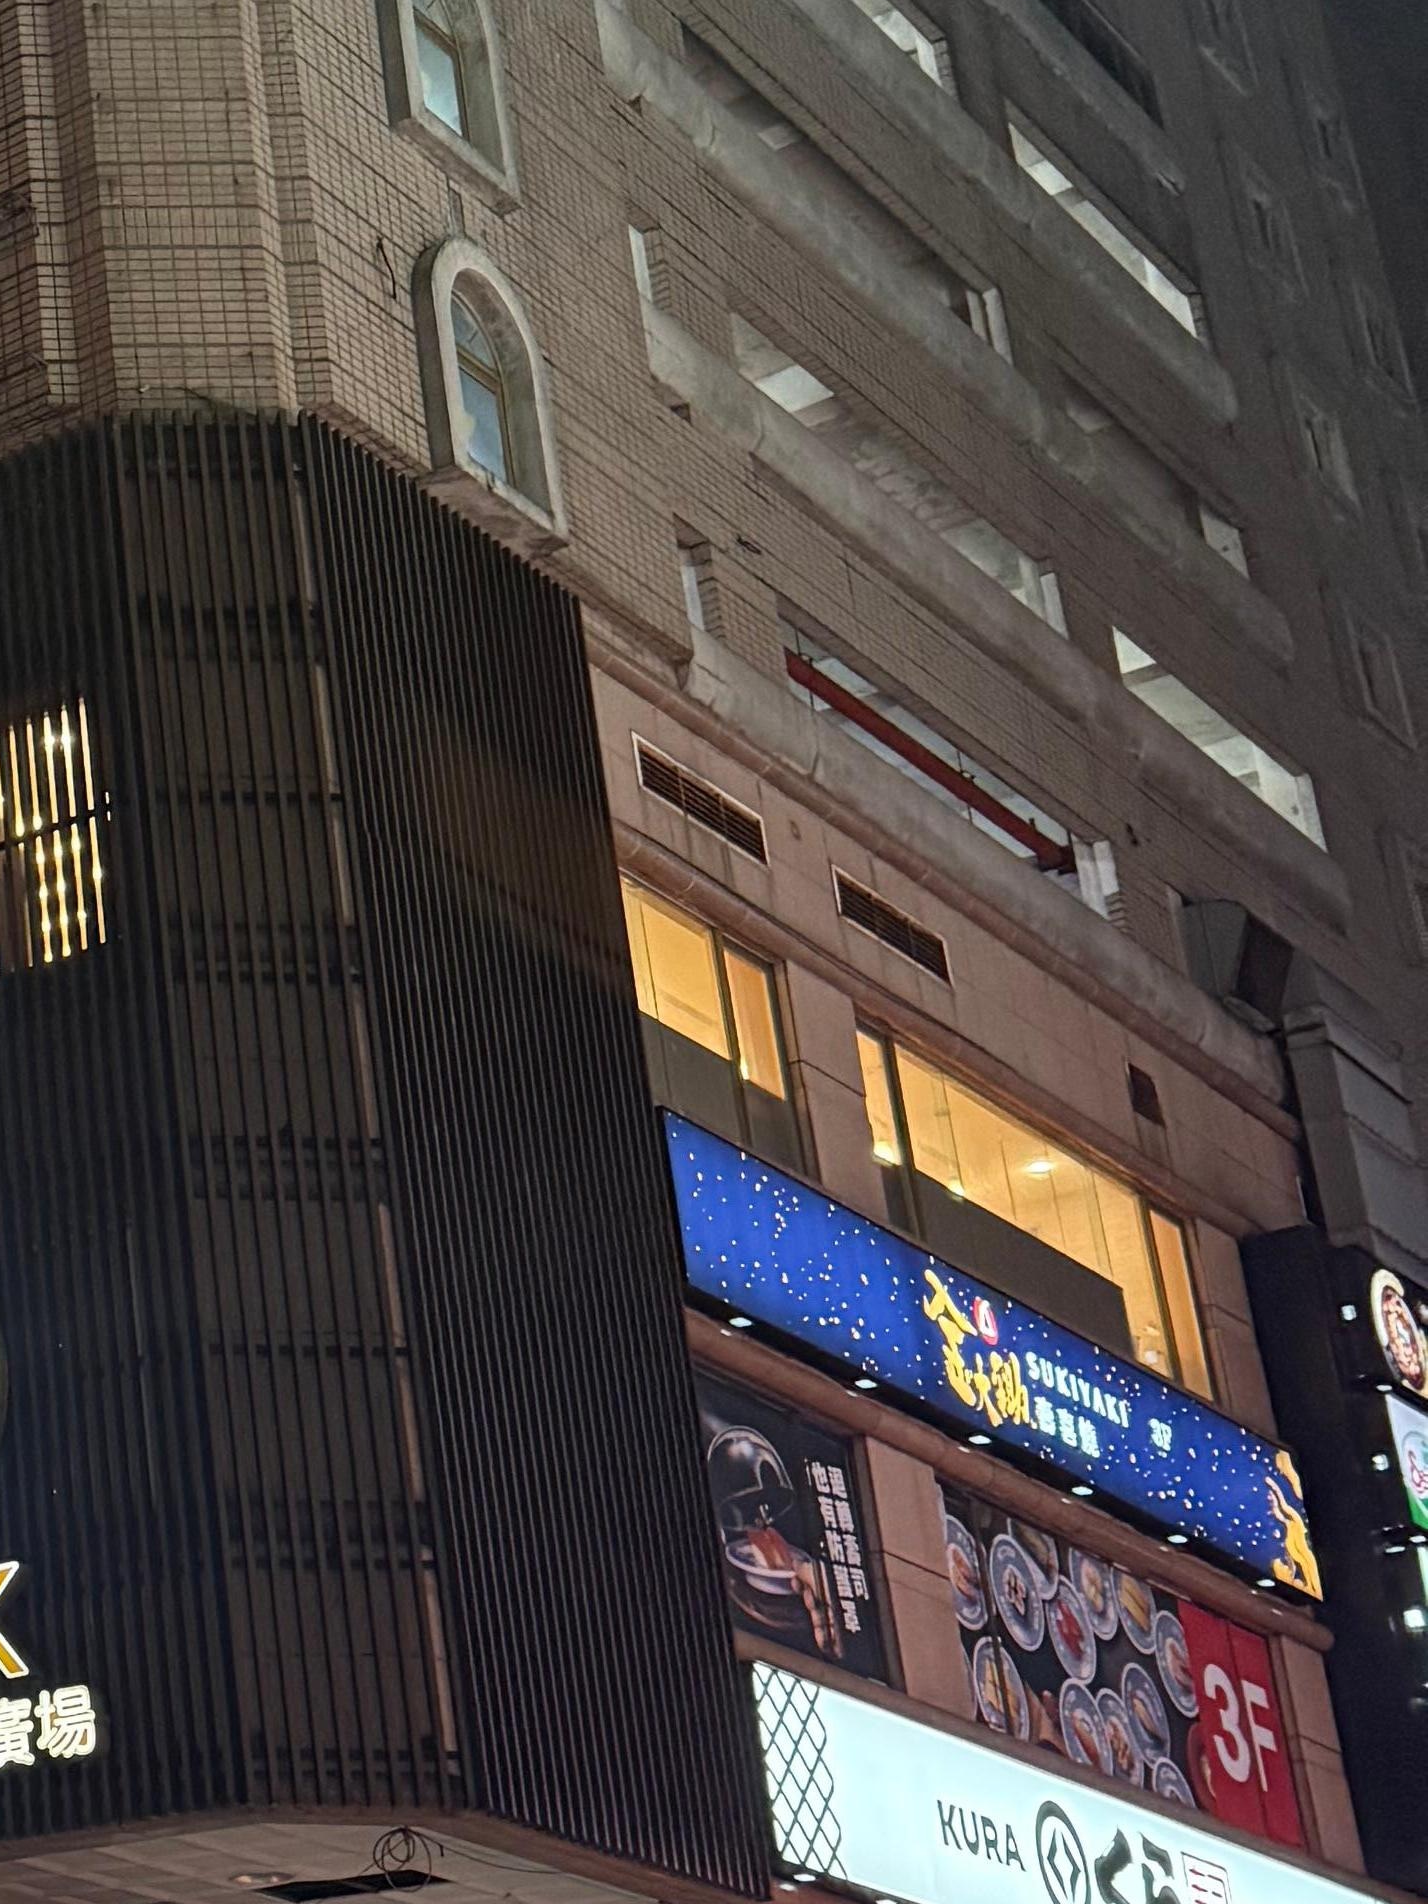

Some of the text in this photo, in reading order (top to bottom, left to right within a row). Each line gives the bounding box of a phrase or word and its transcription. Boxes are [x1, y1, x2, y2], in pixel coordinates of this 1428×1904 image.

[1024, 1350, 1131, 1428] SUKIYAKI
[1203, 1662, 1279, 1794] 3F
[936, 1798, 1027, 1873] KURA
